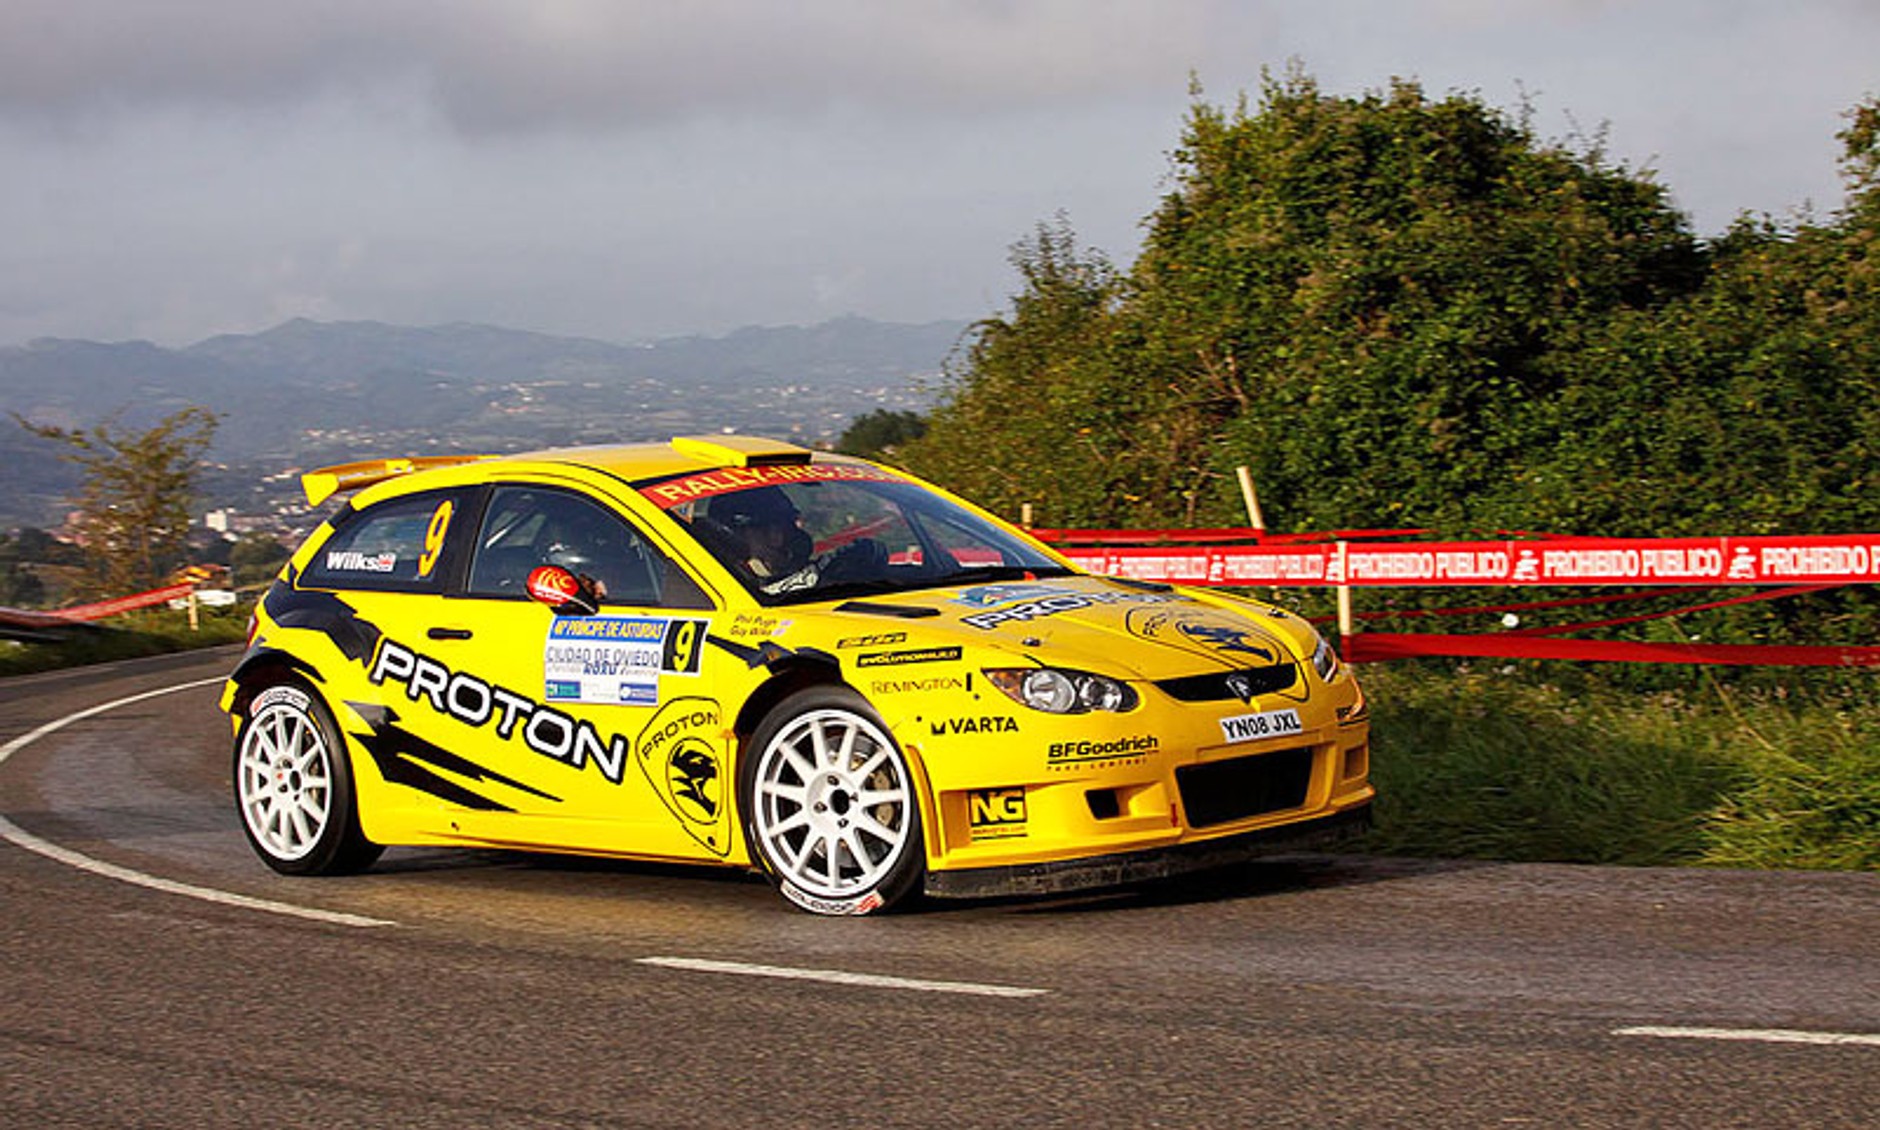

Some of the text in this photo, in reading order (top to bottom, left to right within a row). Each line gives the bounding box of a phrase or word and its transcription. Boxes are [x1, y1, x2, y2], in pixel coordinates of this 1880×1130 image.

[418, 500, 453, 577] 9
[326, 552, 379, 570] Wilks
[1348, 552, 1510, 579] PROHIBIDO PUBLICO
[1544, 548, 1722, 577] PROHIBIDO PUBLICO
[1762, 546, 1869, 575] PROHIBIDO
[607, 621, 618, 637] DE
[619, 622, 665, 639] ASTURIAS
[547, 646, 661, 668] CIUDAD DE OVIEDO
[673, 620, 696, 672] 9
[871, 677, 963, 695] REMINGTON
[371, 641, 628, 782] PROTON
[949, 716, 1019, 734] VARTA
[1222, 711, 1301, 739] YN08 JXL
[641, 711, 718, 760] PROTON
[1048, 735, 1158, 757] BFGoodrich
[971, 790, 1027, 824] NG
